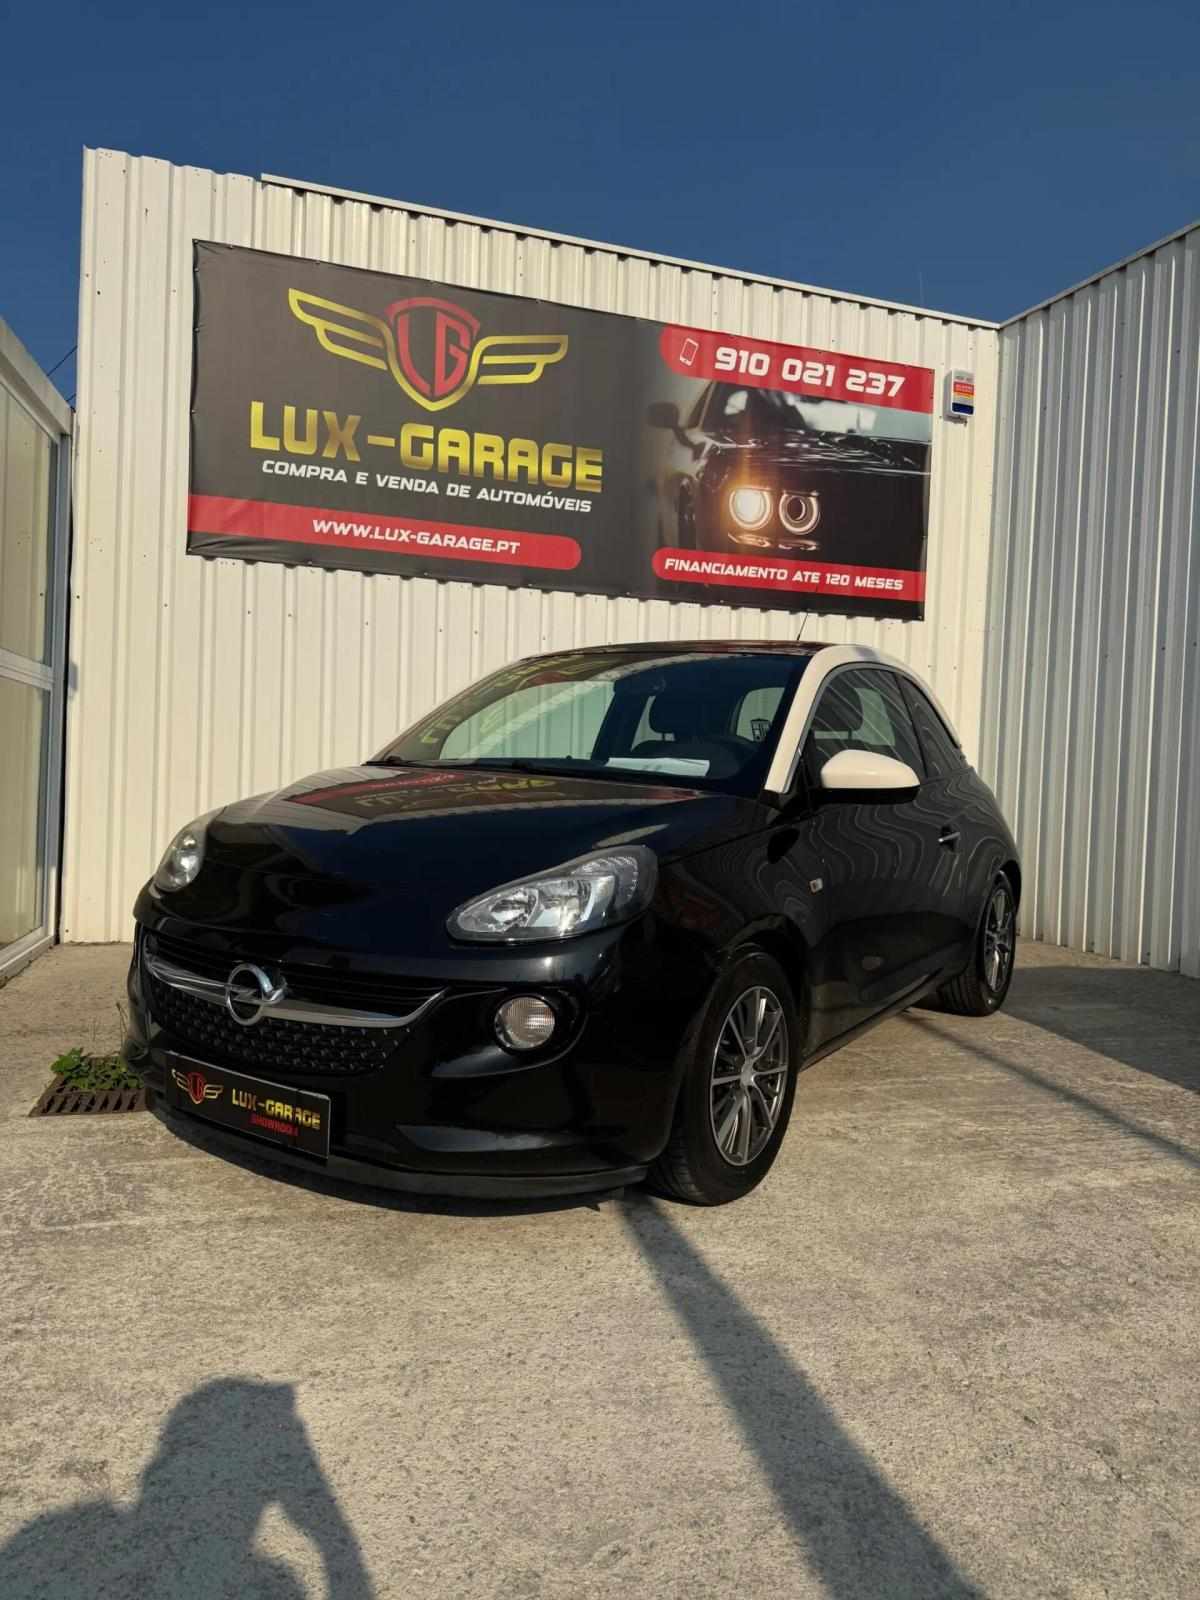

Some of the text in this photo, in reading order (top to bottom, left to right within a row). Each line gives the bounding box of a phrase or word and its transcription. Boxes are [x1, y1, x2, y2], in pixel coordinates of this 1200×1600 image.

[714, 346, 905, 397] 910 021 237
[250, 401, 602, 493] LUX-GARAGE
[262, 459, 592, 512] COMPRA E VENDA DE AUTOMÓVEIS
[312, 519, 521, 554] WWW.LUX-GARAGE.PT
[664, 558, 904, 591] FINANCIAMENTO ATE 120 MESES
[232, 1088, 320, 1130] LUX-GARAGE
